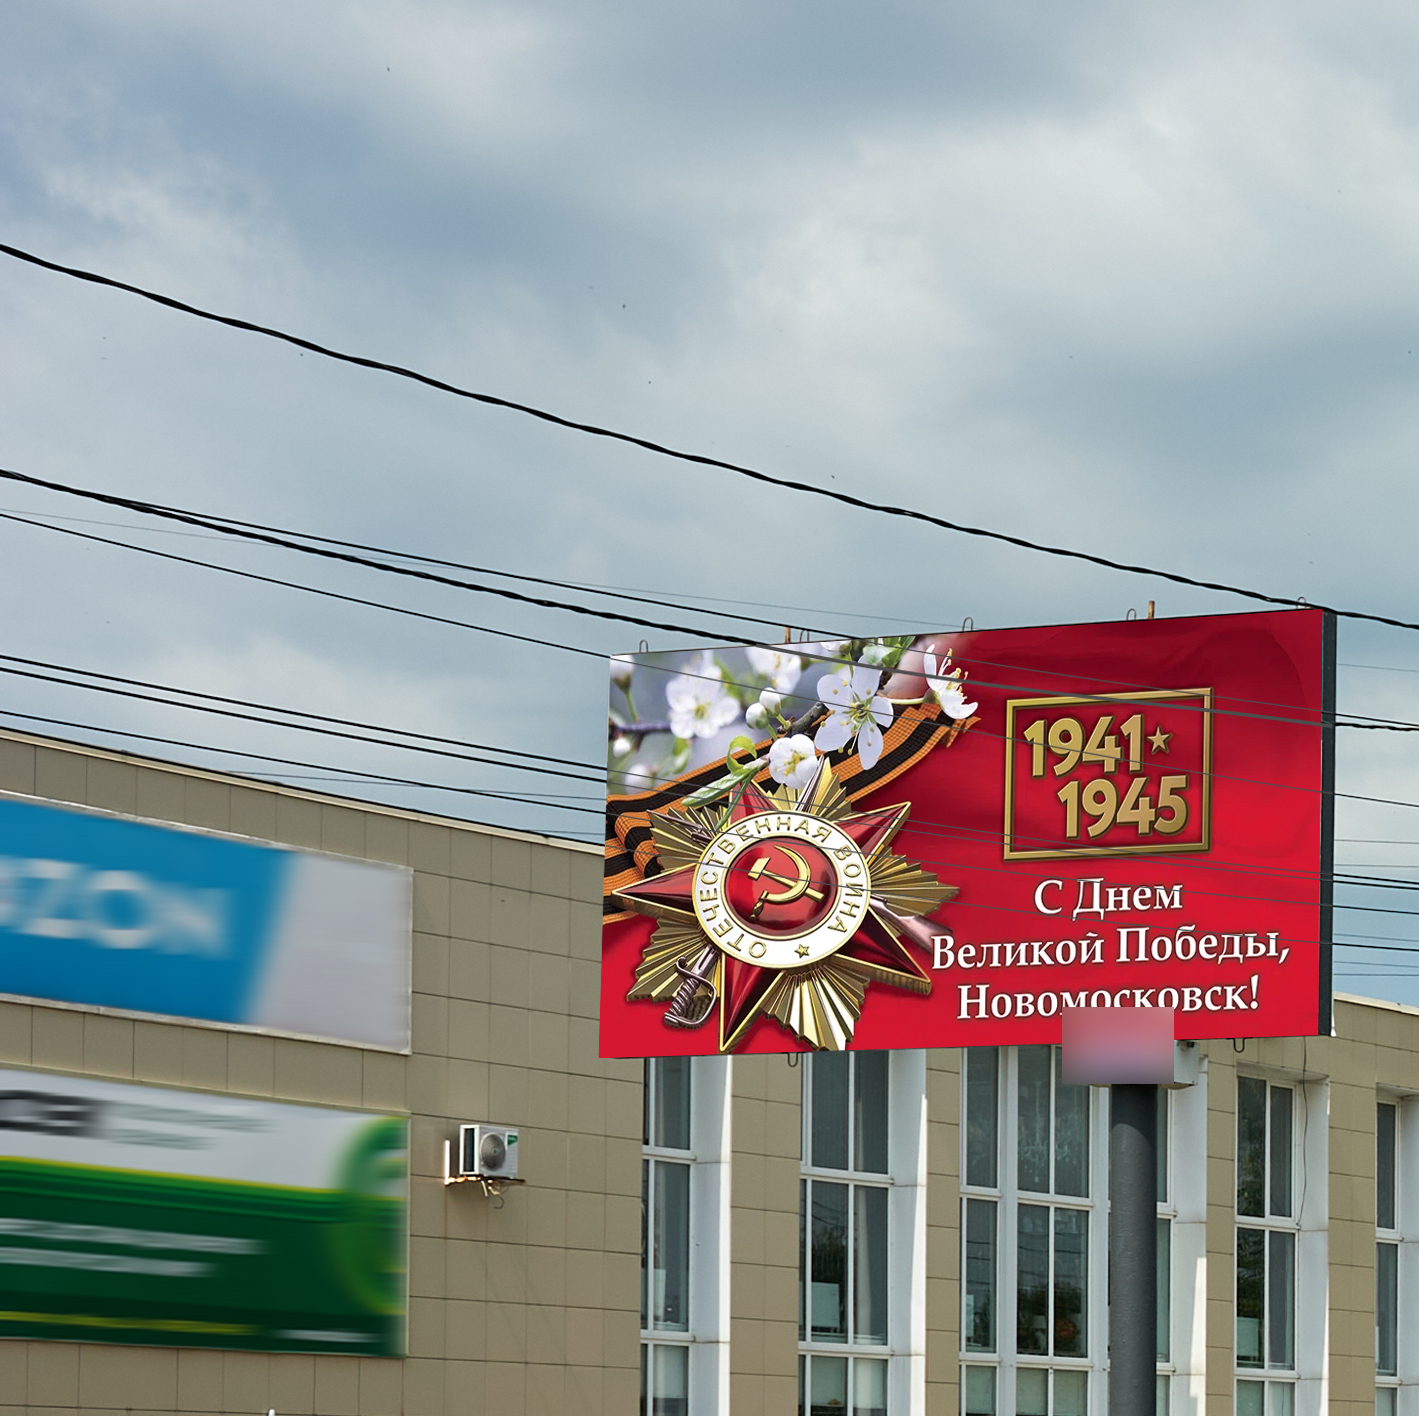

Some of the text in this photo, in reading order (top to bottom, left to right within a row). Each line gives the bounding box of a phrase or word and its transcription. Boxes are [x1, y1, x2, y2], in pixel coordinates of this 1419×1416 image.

[1023, 714, 1144, 777] 1941
[1057, 775, 1189, 839] 1945
[699, 816, 832, 959] ОТЕЧЕСТВЕННАЯ
[1034, 878, 1183, 922] С Днем
[931, 924, 1290, 970] Великой Победы,
[957, 975, 1261, 1020] Новомосковск!
